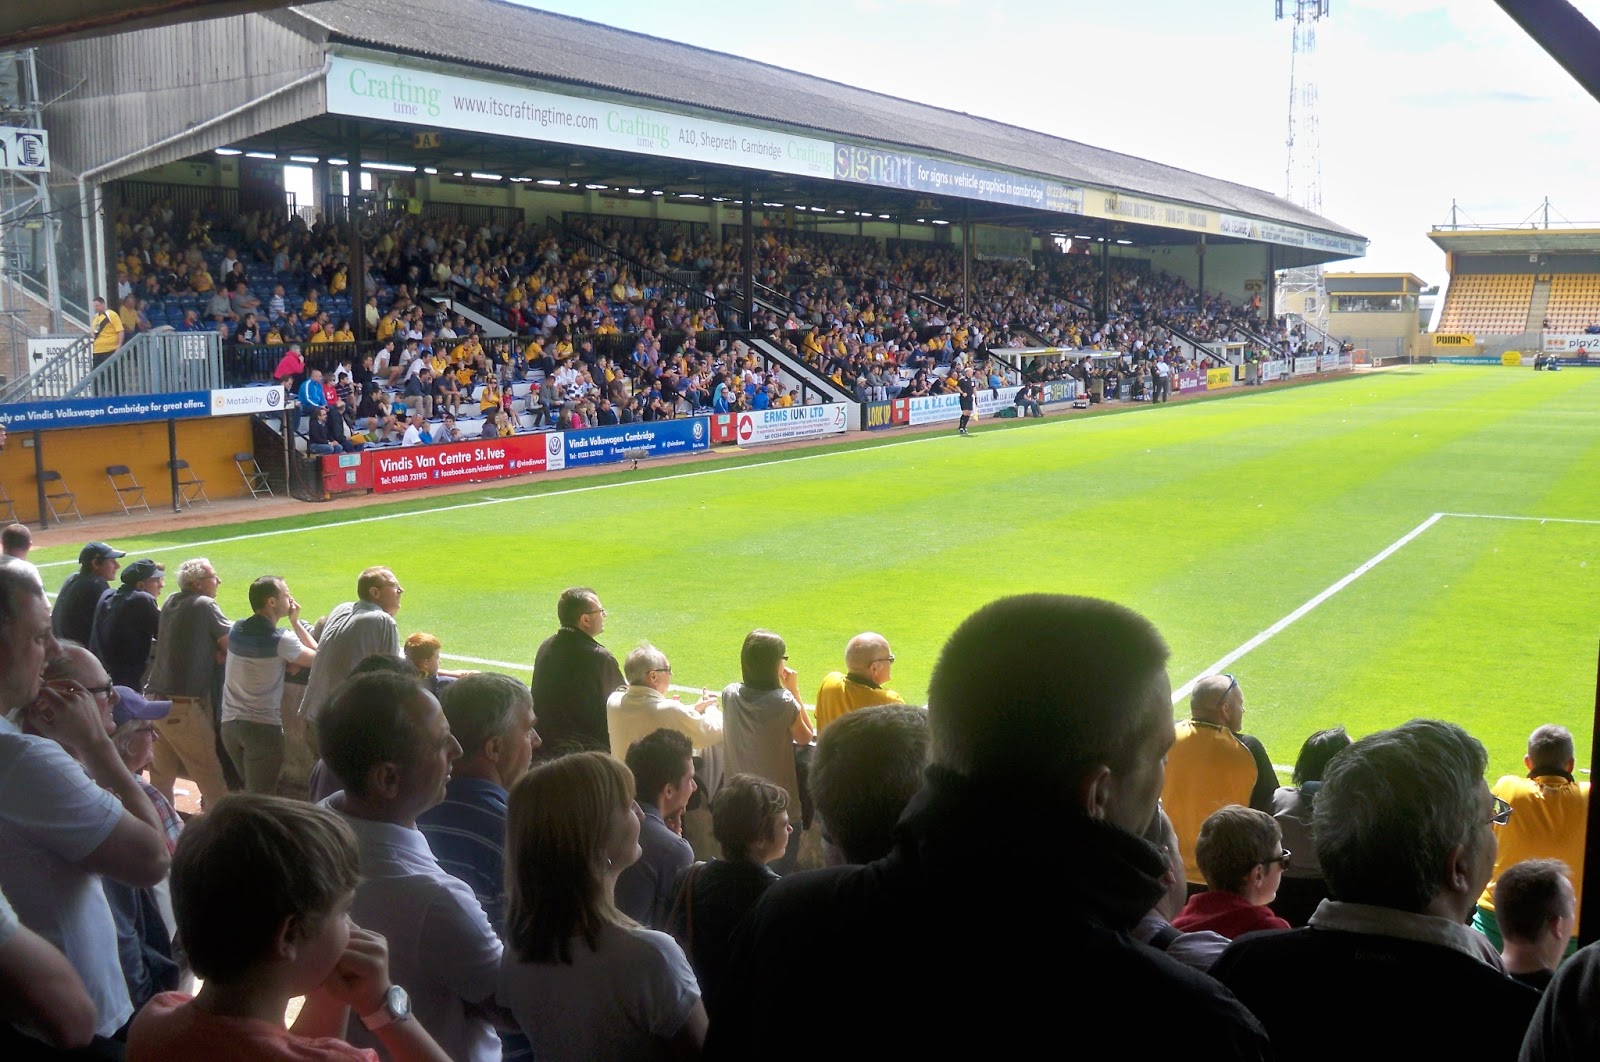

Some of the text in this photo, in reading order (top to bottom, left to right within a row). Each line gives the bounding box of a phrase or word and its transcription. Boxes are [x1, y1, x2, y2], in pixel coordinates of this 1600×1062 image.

[350, 68, 441, 117] Crafting
[393, 101, 418, 115] time
[453, 94, 599, 130] www.itscraftingtime.com
[607, 110, 671, 149] Crafting
[636, 136, 654, 148] time
[678, 128, 782, 159] A10, Shepreth Cambridge
[787, 140, 833, 172] Crafting
[918, 166, 929, 181] for
[930, 170, 948, 187] signs
[954, 172, 978, 189] vehicle
[979, 177, 1006, 198] graphics
[1006, 181, 1013, 193] in
[1013, 181, 1043, 202] cambridge
[1436, 336, 1462, 344] PUMA
[14, 413, 26, 421] on
[27, 409, 54, 421] Vindis
[56, 407, 104, 421] Volkswagen
[107, 402, 150, 416] Cambridge
[150, 401, 162, 411] for
[163, 400, 183, 412] great
[183, 399, 206, 410] offers.
[226, 395, 263, 407] Motability
[764, 410, 787, 423] ERMS
[791, 408, 807, 420] (UK)
[810, 407, 824, 418] LTD
[569, 430, 655, 449] Vindis Volkswagen Cambridge
[380, 456, 413, 472] Vindis
[416, 455, 436, 467] Van
[439, 452, 472, 466] Centre
[381, 476, 392, 485] Tel:
